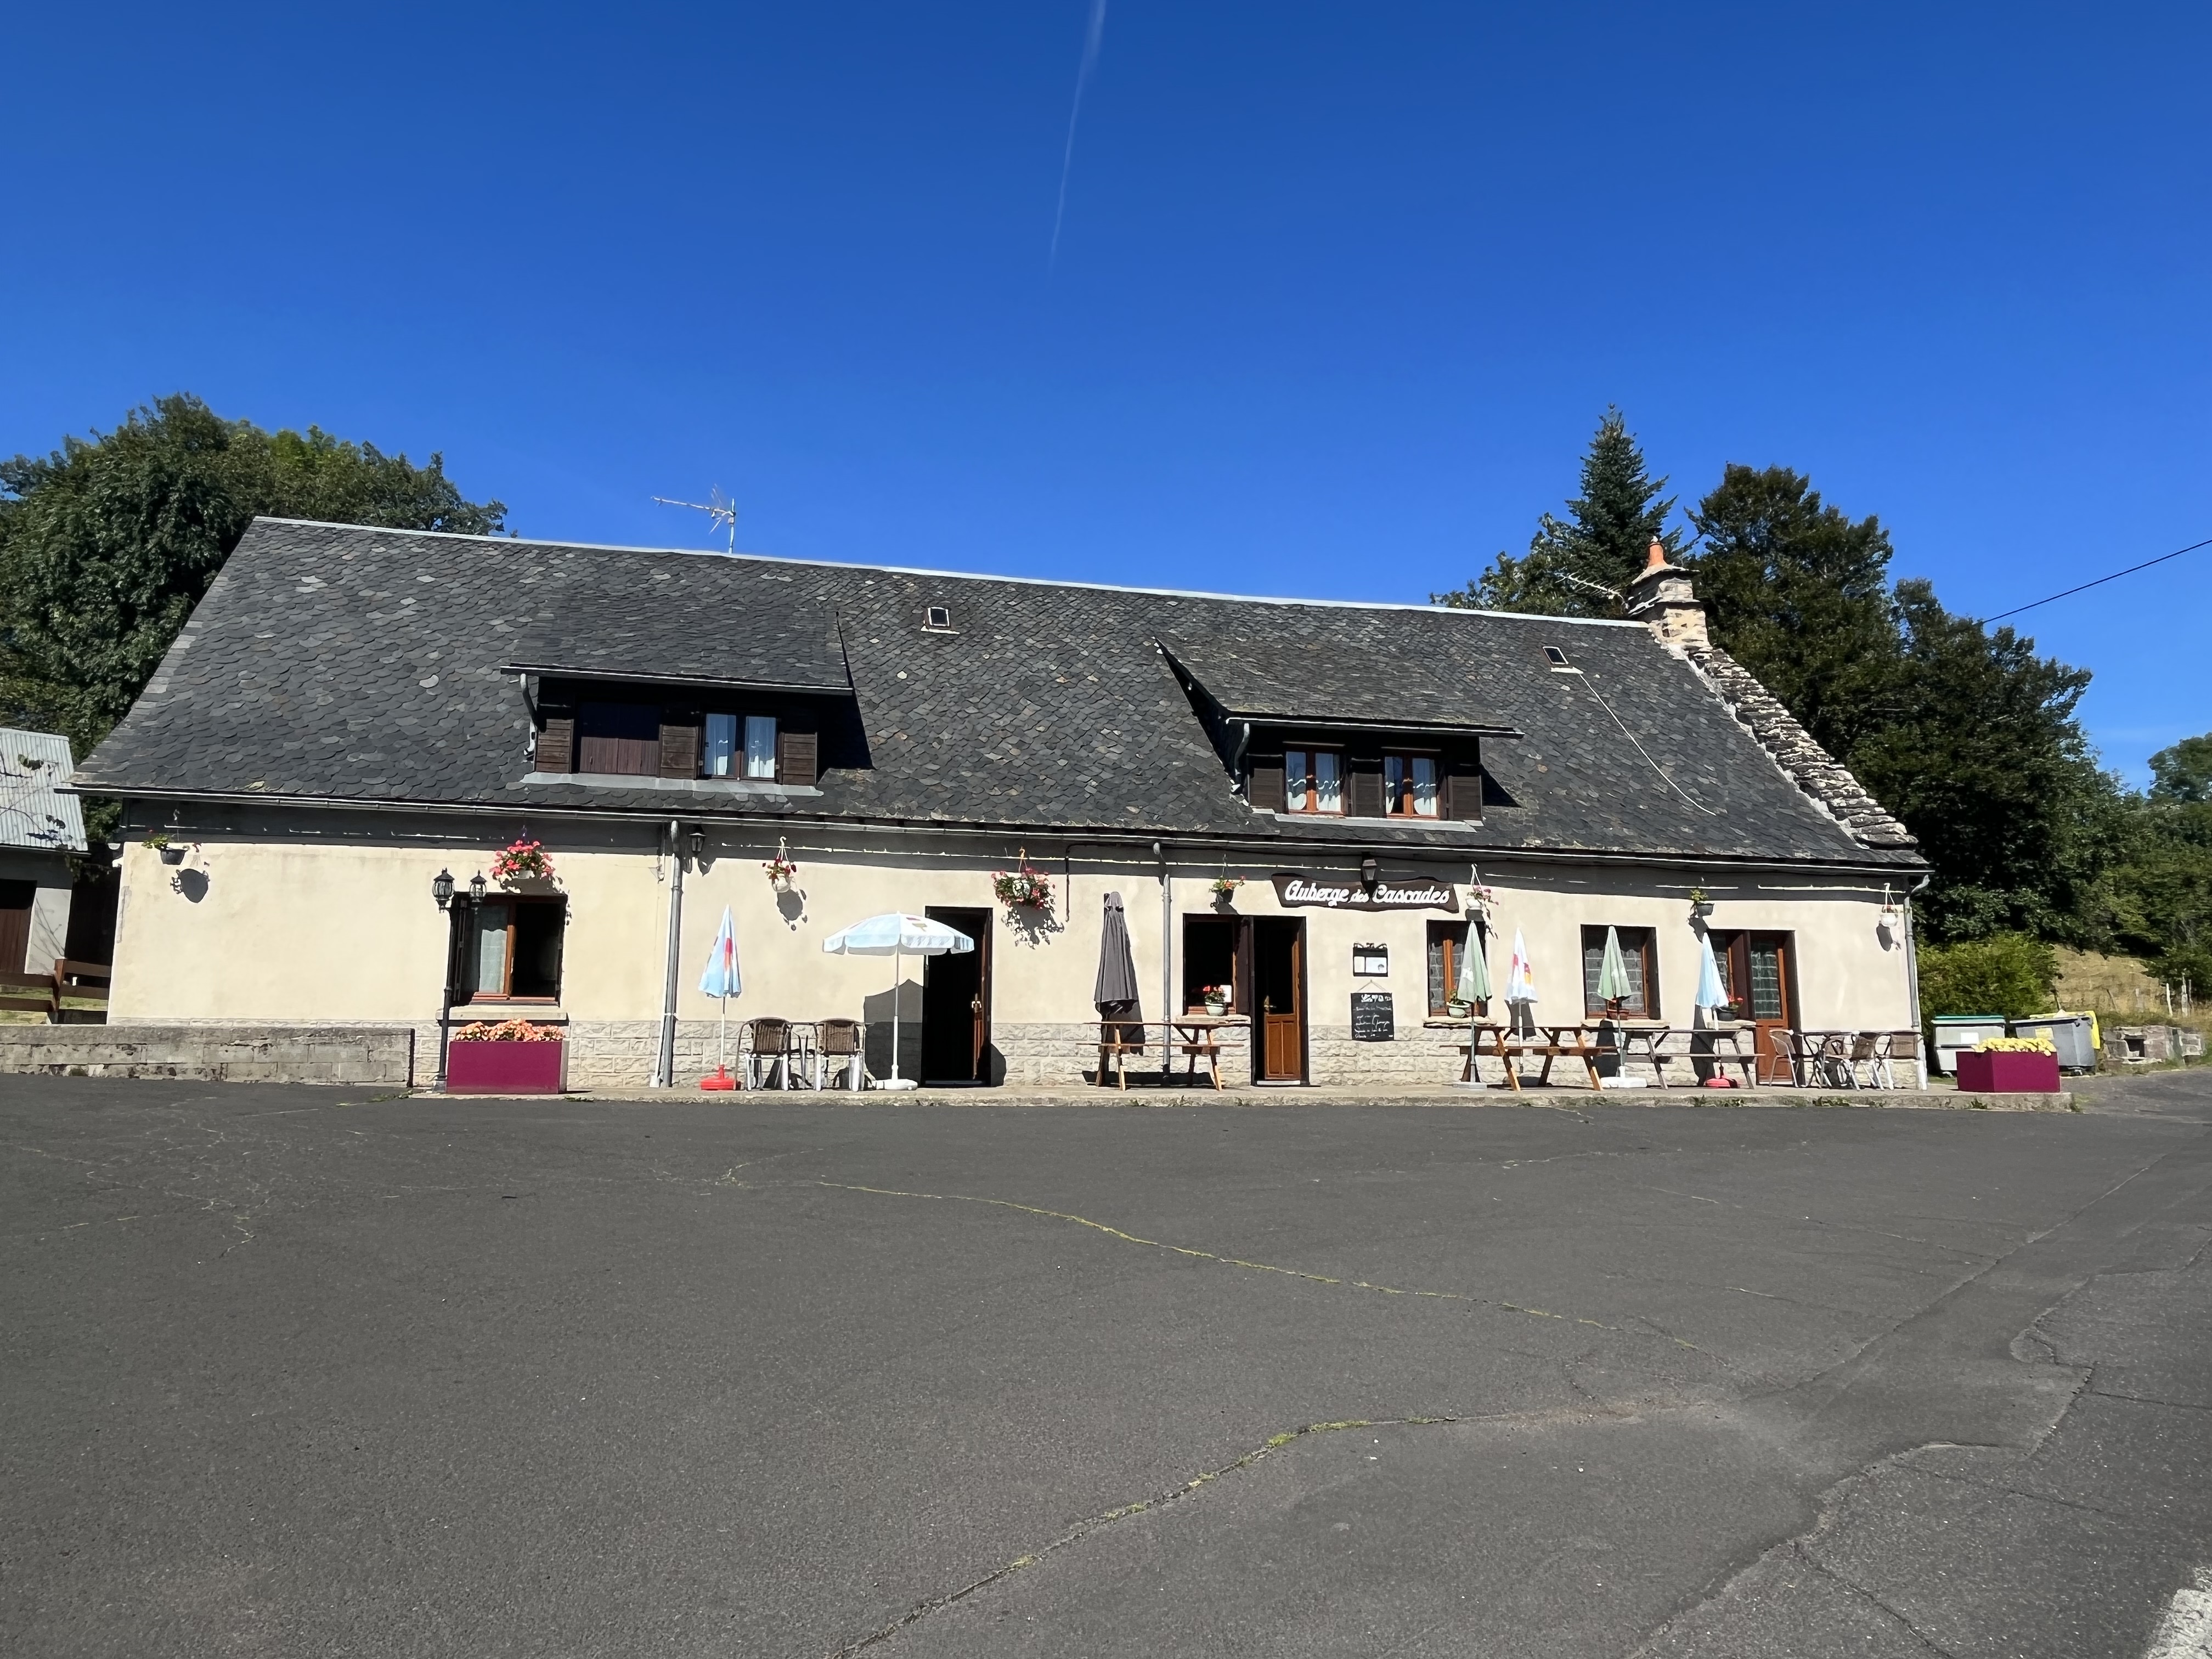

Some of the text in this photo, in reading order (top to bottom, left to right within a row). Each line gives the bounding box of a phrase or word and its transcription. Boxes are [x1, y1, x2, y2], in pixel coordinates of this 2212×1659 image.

[1284, 880, 1450, 906] Auberge des Cascades
